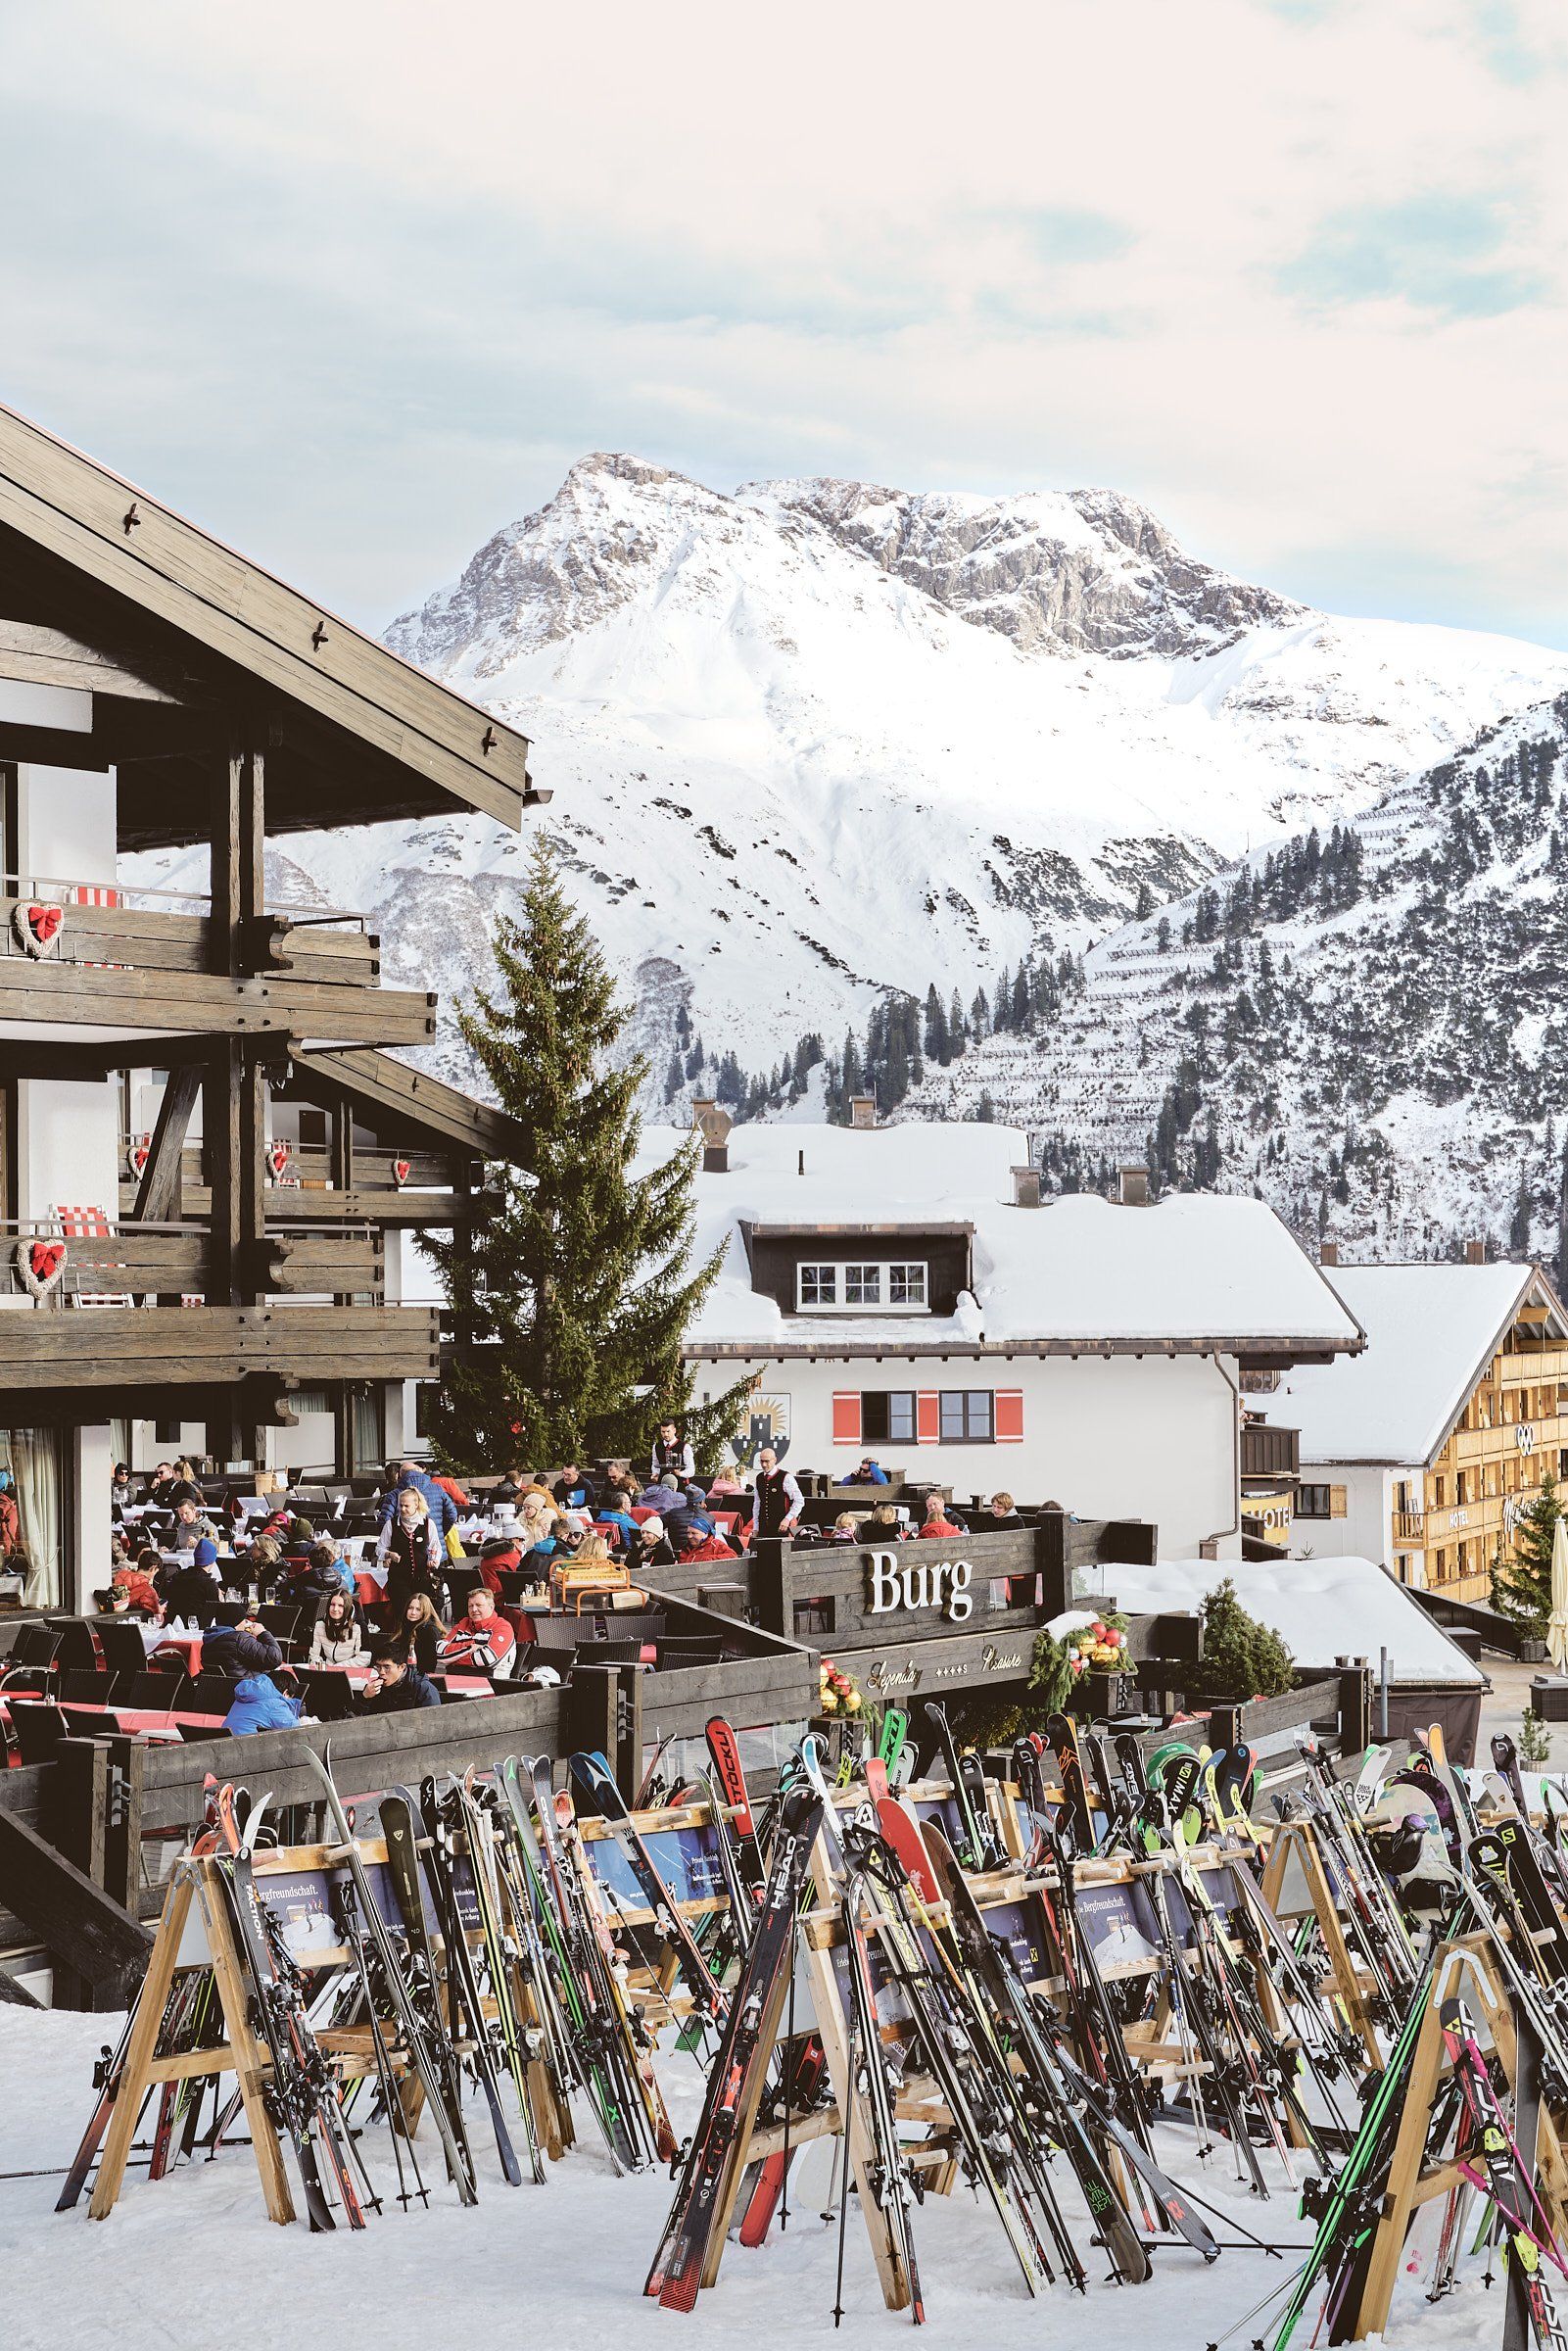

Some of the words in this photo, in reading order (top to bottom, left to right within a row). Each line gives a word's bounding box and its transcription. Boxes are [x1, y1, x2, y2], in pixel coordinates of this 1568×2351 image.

[1449, 1511, 1468, 1528] HOTEL
[871, 1551, 973, 1622] Burg
[867, 1659, 923, 1696] Legendary
[981, 1644, 1022, 1672] Pleasure
[715, 1730, 743, 1805] STÖCKLI
[883, 1716, 901, 1770] CKLI
[541, 1796, 558, 1855] HEAD
[259, 1885, 319, 1902] ergfreundschaft.
[771, 1835, 796, 1909] HEAD
[246, 1885, 264, 1941] FACTION
[1083, 1895, 1126, 1913] Bergfreundschaft.
[836, 1957, 849, 1968] Erleb
[1084, 2179, 1100, 2192] ALL
[1089, 2186, 1107, 2203] MTN
